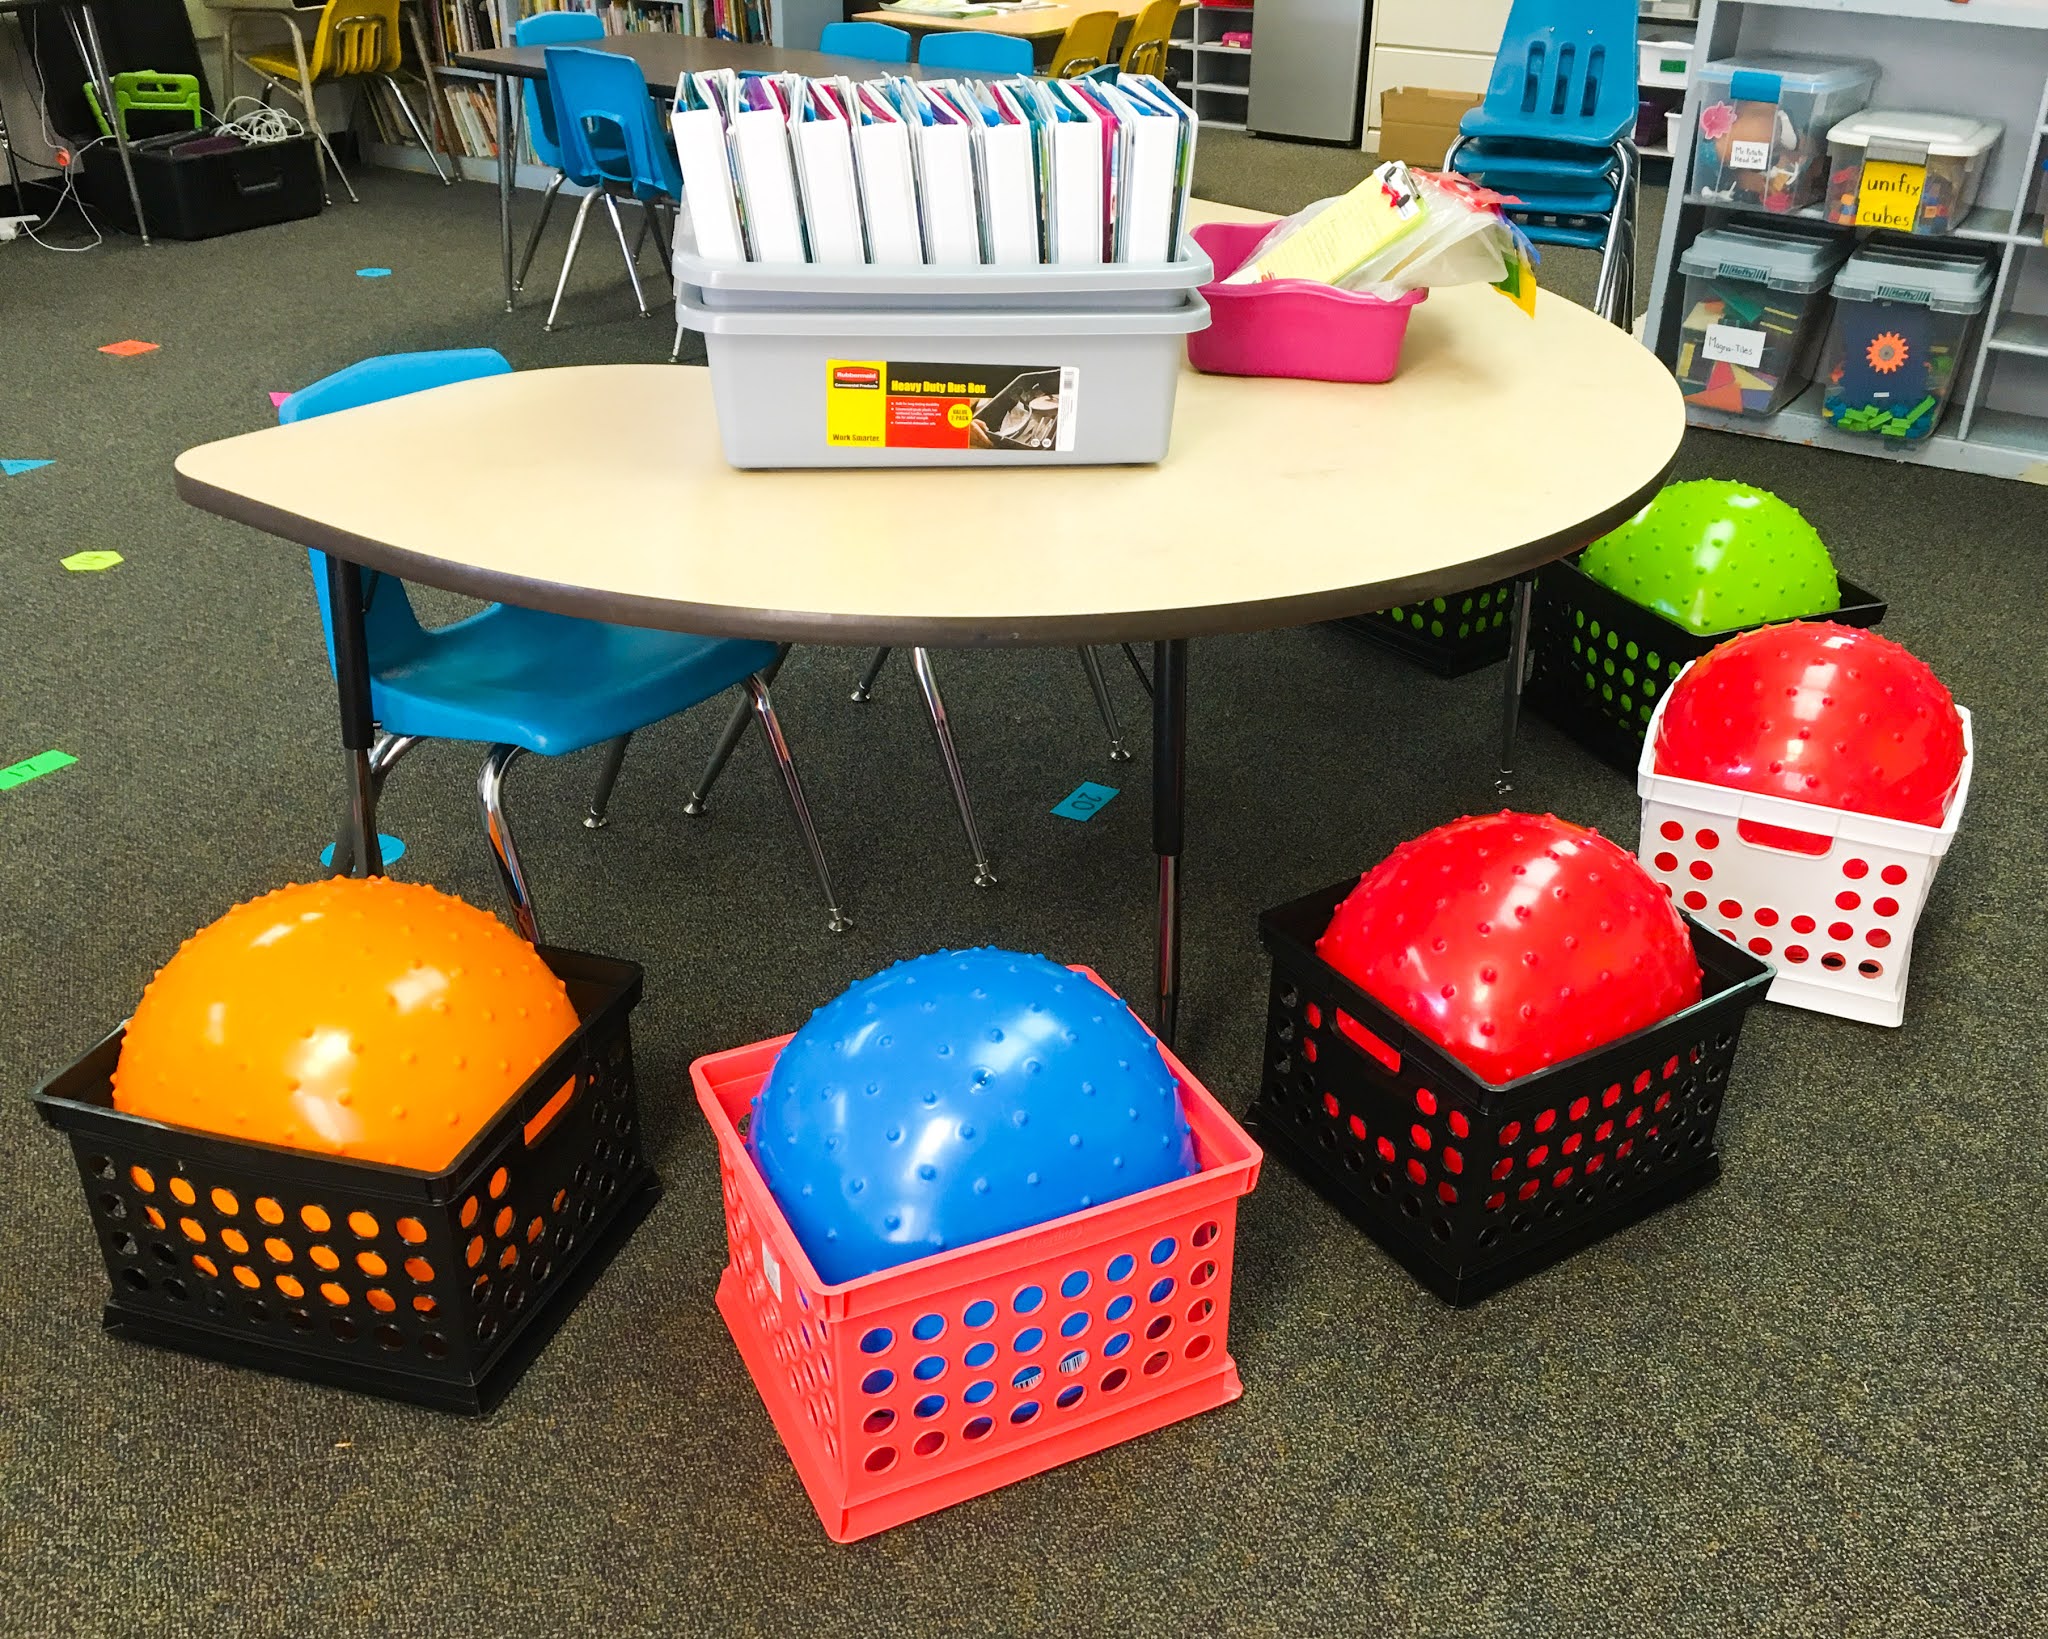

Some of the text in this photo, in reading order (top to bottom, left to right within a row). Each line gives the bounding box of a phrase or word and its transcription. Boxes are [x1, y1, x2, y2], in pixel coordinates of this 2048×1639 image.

[1867, 173, 1920, 196] unifix
[1863, 205, 1910, 226] cubes
[836, 371, 877, 379] Rubbermaid
[891, 380, 987, 394] Heavy Duty Bus Box
[851, 434, 880, 442] Smarter
[1071, 792, 1103, 811] 20
